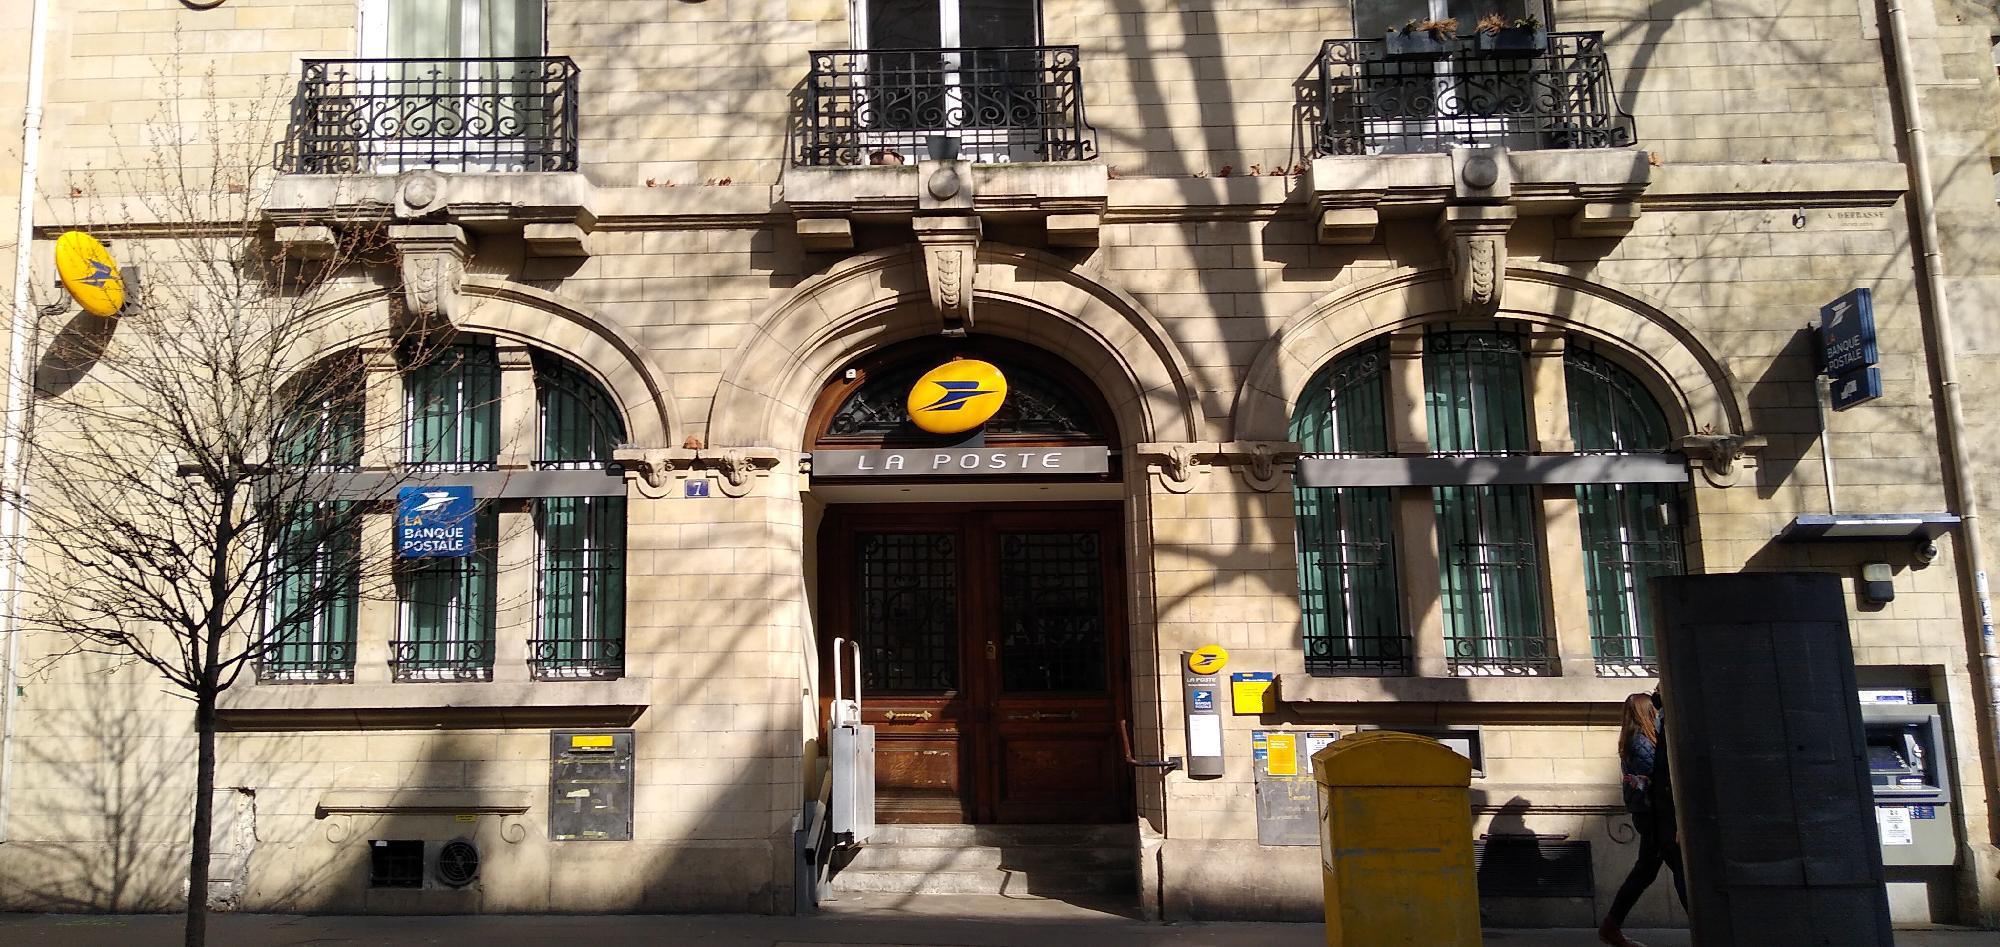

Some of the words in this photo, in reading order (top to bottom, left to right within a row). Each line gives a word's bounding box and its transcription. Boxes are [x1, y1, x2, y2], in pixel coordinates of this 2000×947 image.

[1826, 334, 1861, 359] BANQUE
[1828, 348, 1863, 369] POSTALE
[858, 454, 905, 470] LA
[932, 452, 1063, 470] POSTE
[692, 480, 702, 496] 7
[404, 515, 423, 526] LA
[404, 527, 464, 539] BANQUE
[403, 540, 464, 552] POSTALE
